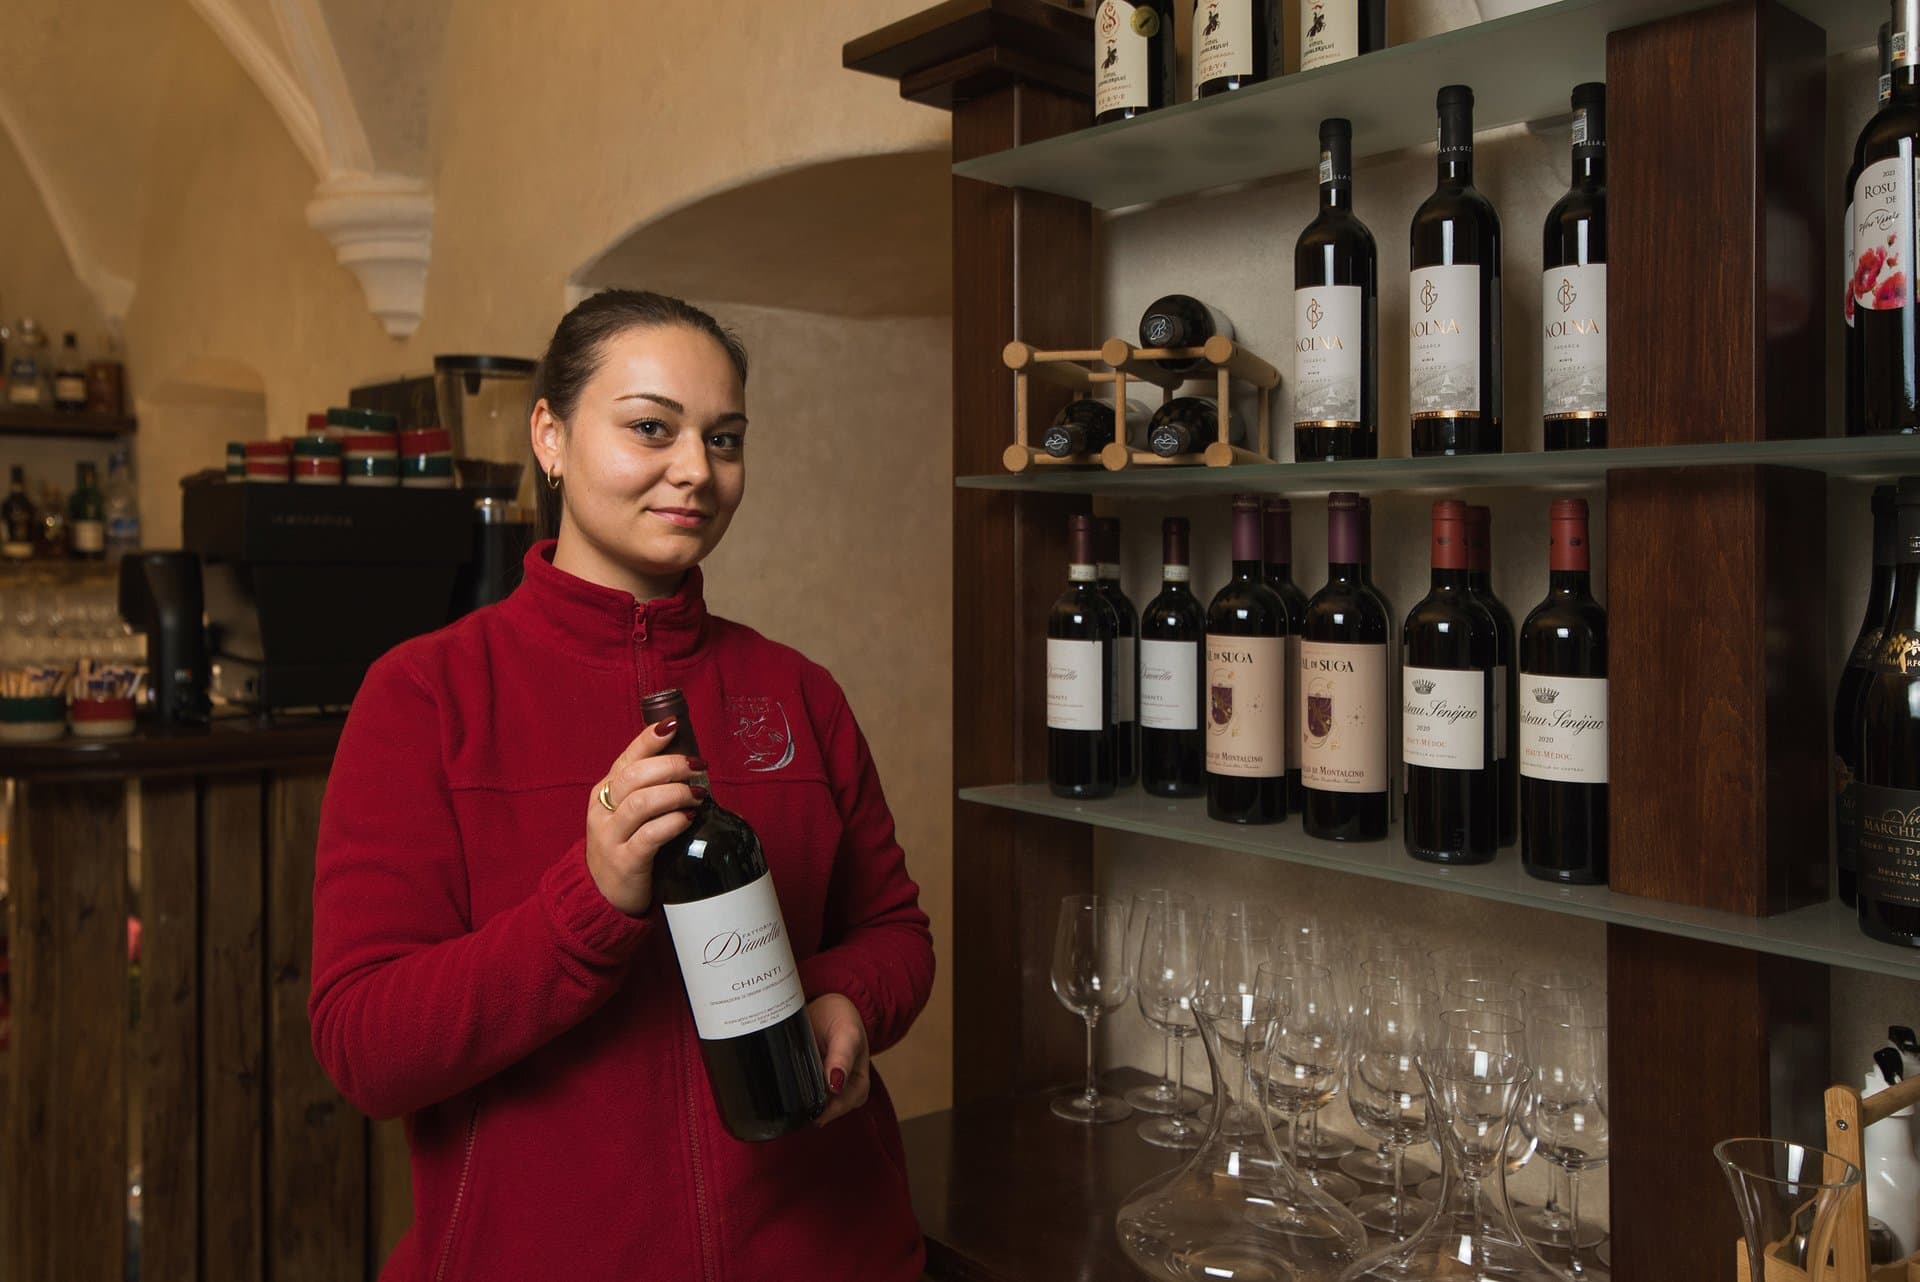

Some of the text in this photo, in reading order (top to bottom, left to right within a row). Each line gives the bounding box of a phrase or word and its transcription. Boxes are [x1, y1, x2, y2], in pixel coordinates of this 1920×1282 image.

[1864, 181, 1896, 200] ROSU
[1886, 195, 1897, 205] DE
[1221, 651, 1253, 664] SUGA
[1319, 659, 1354, 673] SUGA
[1538, 735, 1554, 744] 2020
[1221, 751, 1263, 763] MONTALCINO
[1319, 765, 1364, 778] MONTALCINO
[731, 965, 781, 991] CHIANTI
